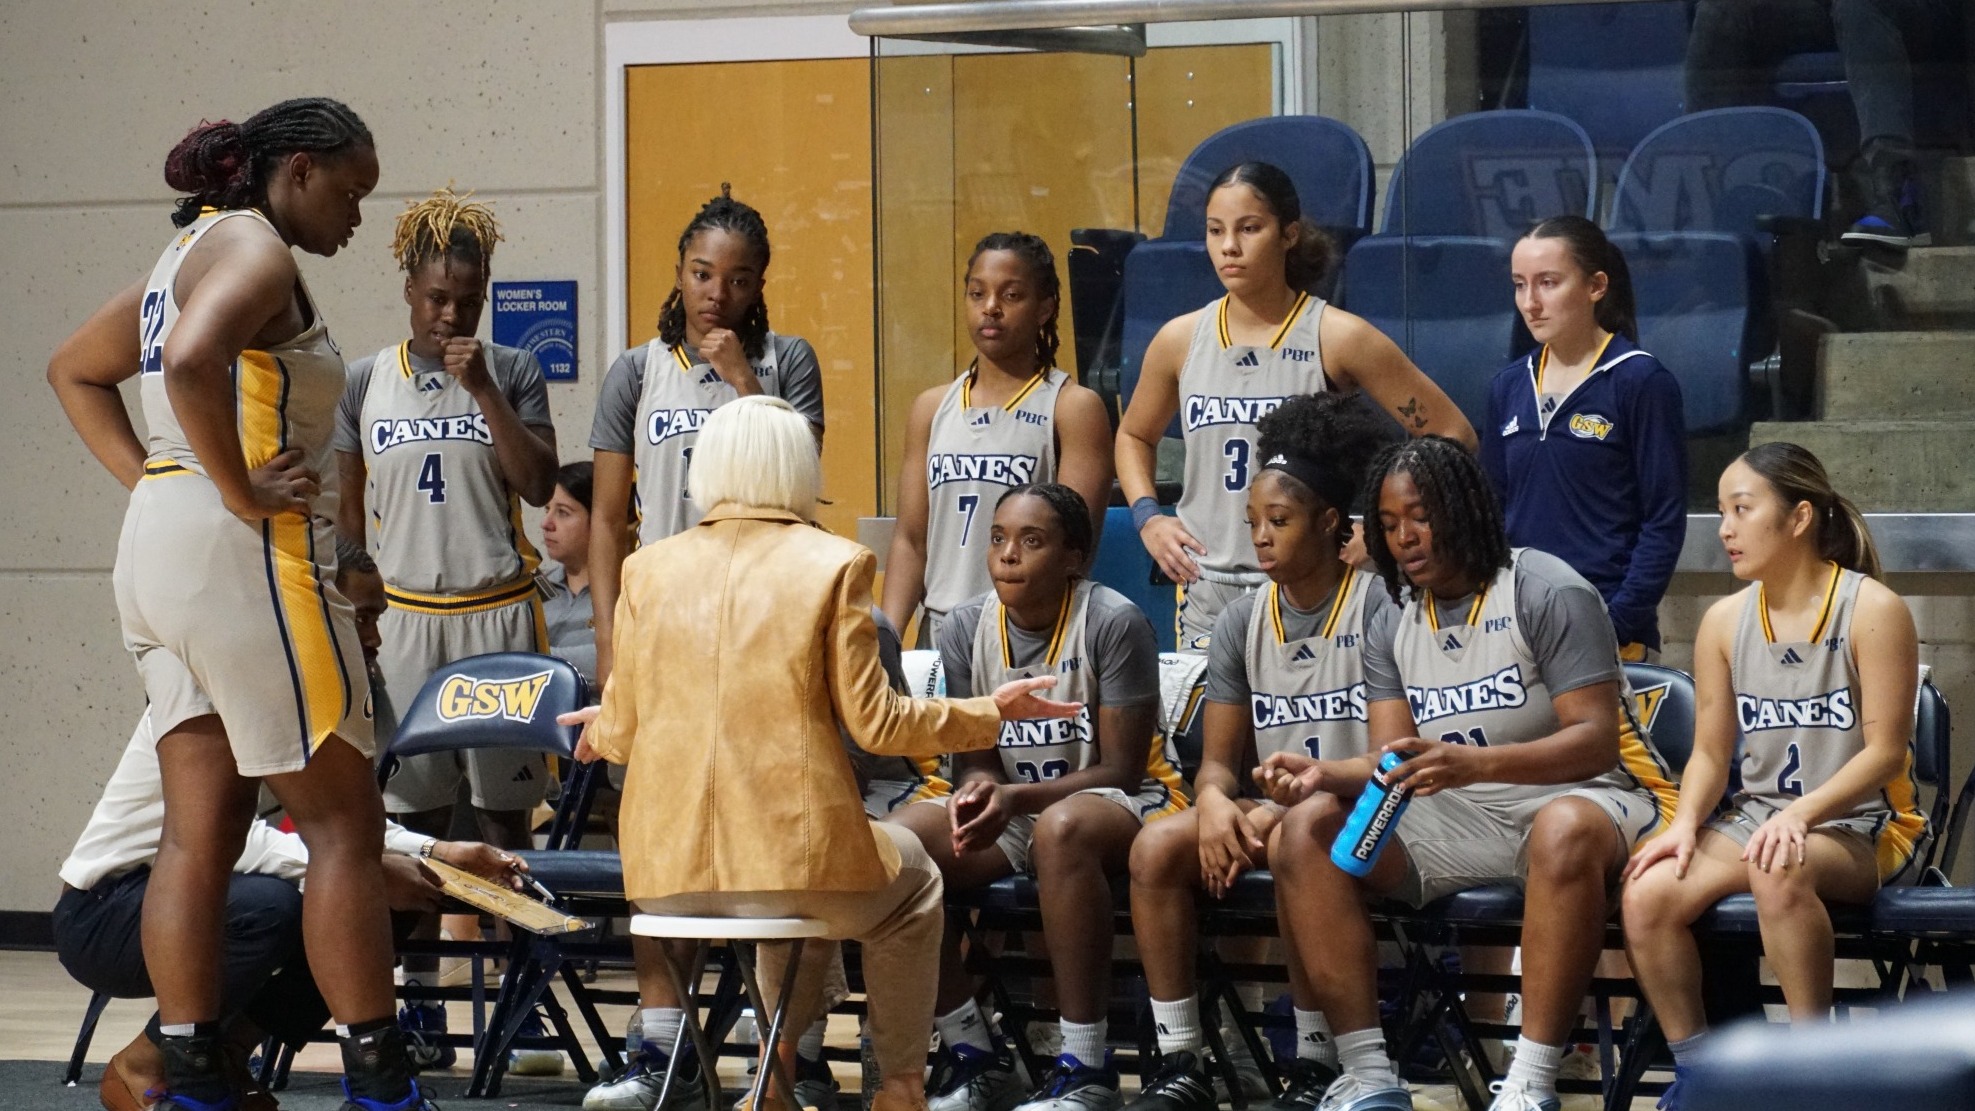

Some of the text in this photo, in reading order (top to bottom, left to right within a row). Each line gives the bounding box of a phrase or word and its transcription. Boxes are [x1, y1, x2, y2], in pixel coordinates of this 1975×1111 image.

[497, 289, 542, 300] WOMEN'S
[497, 301, 567, 312] LOCKER ROOM
[550, 363, 570, 373] 1132
[1282, 347, 1315, 362] PBC
[370, 412, 494, 455] CANES
[1015, 409, 1048, 426] PBC
[1185, 394, 1300, 432] CANE
[1569, 413, 1614, 440] GSW
[416, 451, 447, 505] 4
[928, 453, 1038, 490] CANES
[1223, 436, 1250, 493] 3
[957, 493, 980, 549] 7
[436, 669, 554, 724] GSW
[1251, 682, 1368, 730] CANES
[1407, 663, 1527, 727] CANES
[1737, 687, 1856, 735] CANES
[998, 703, 1094, 749] ANES
[1777, 741, 1804, 797] 2
[1355, 783, 1406, 860] POWERADE
